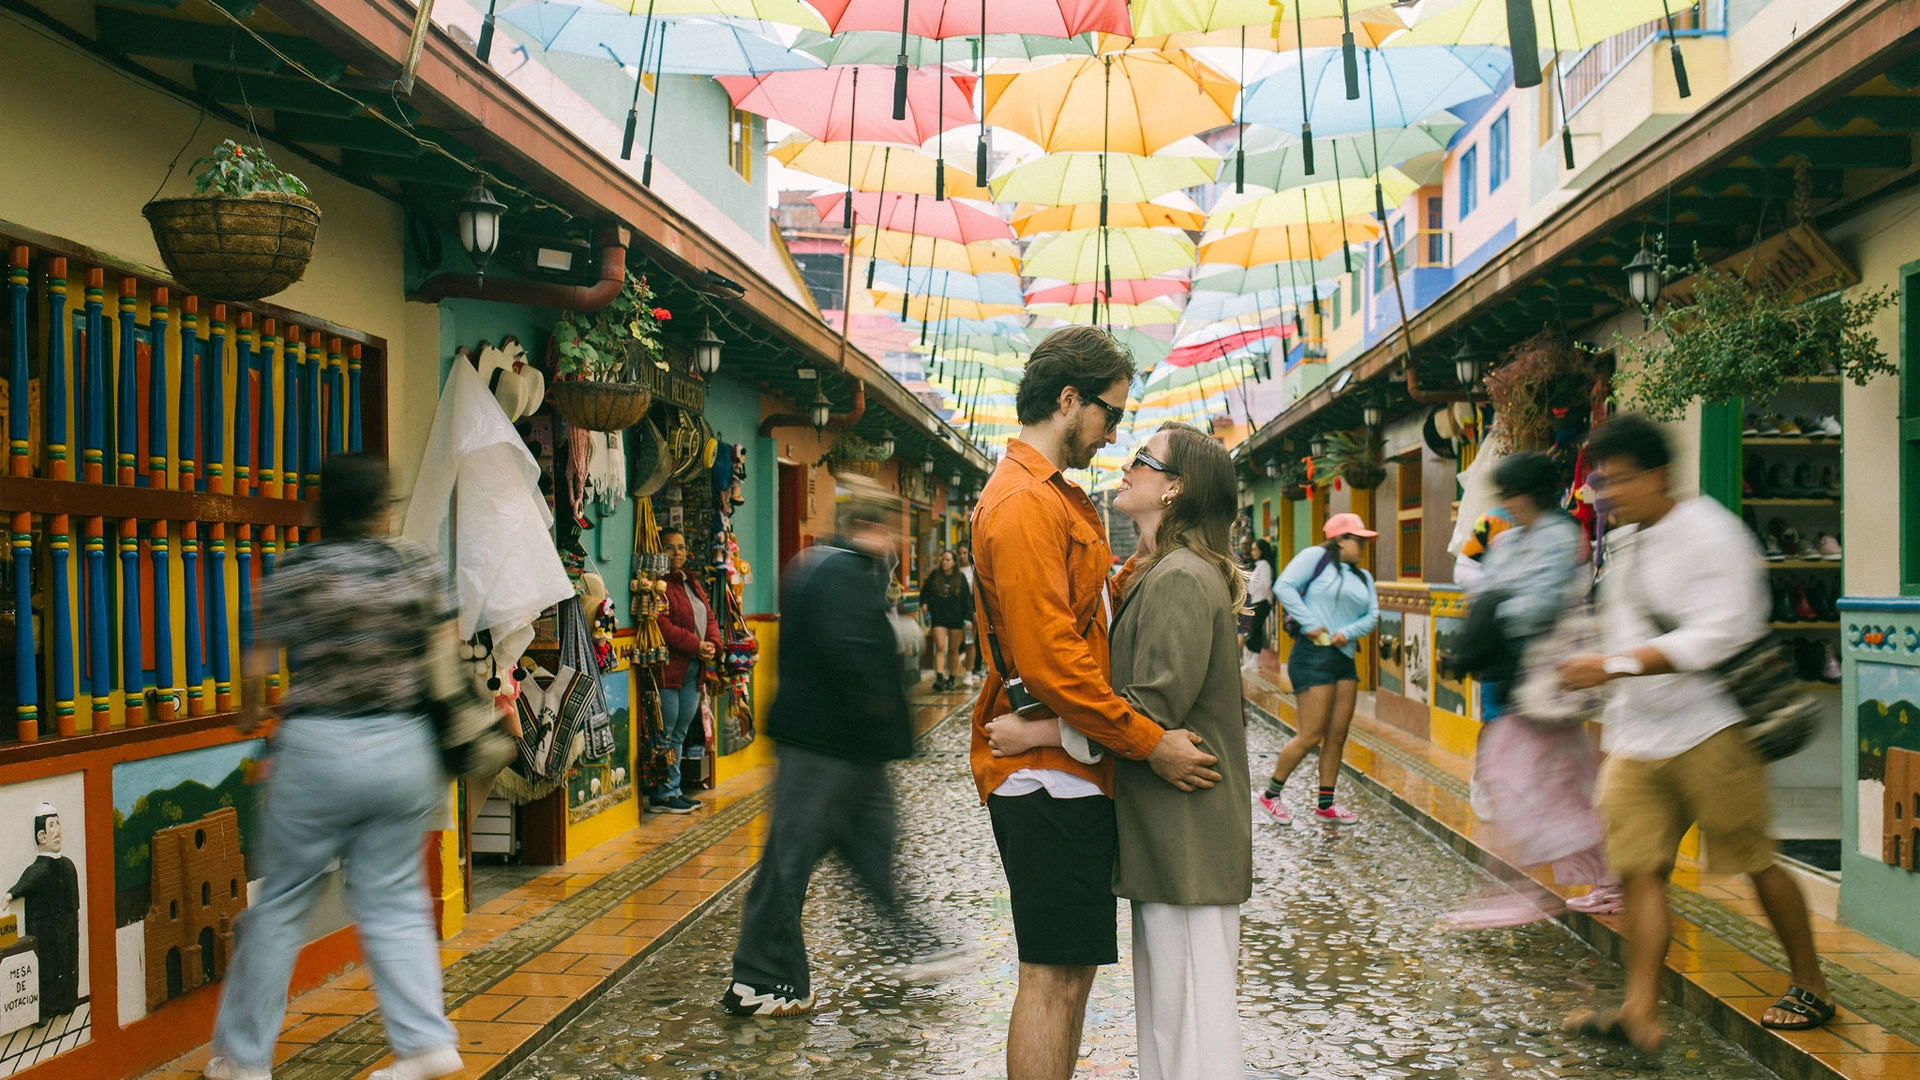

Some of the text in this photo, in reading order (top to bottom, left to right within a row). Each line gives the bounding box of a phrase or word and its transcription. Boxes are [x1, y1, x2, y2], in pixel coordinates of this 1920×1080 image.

[10, 964, 32, 979] MESA
[16, 980, 26, 993] DE
[4, 993, 38, 1012] VOTACION
